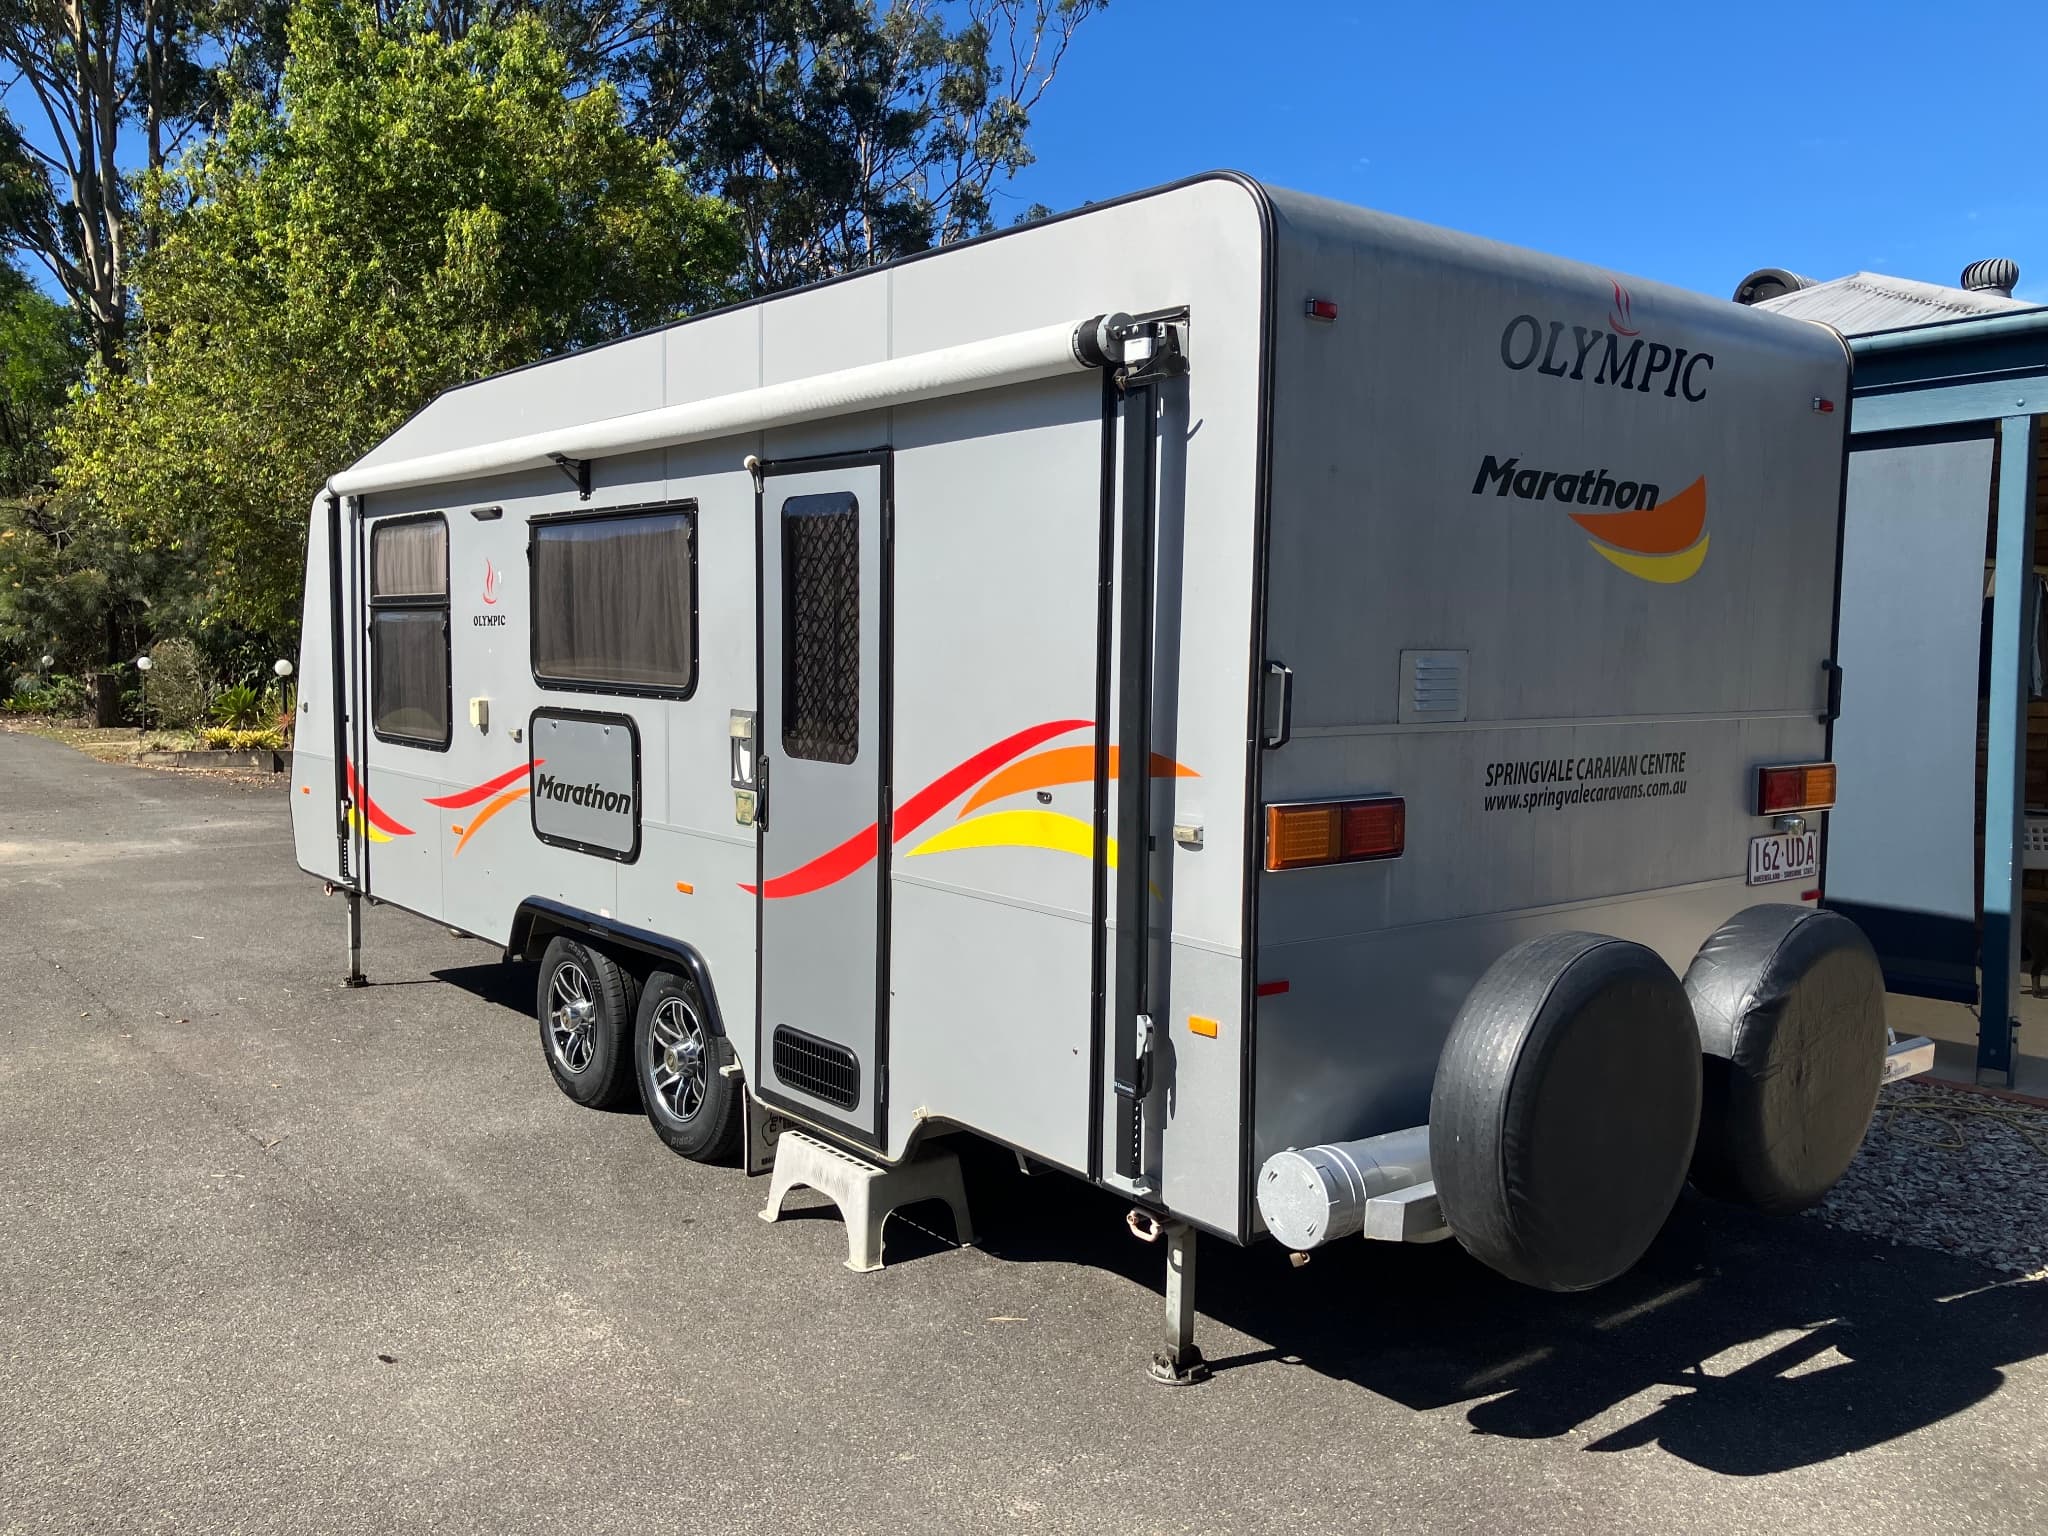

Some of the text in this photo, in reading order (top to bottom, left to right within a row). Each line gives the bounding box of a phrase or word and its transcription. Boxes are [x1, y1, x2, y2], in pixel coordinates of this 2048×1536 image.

[1500, 315, 1714, 402] OLYMPIC
[1471, 455, 1660, 512] Marathon
[473, 614, 506, 627] OLYMPIC
[1485, 751, 1687, 787] SPRINGVALE CARAVAN CENTRE
[537, 773, 632, 815] Marathon
[1484, 780, 1687, 814] www.springvalecaravans.com.au
